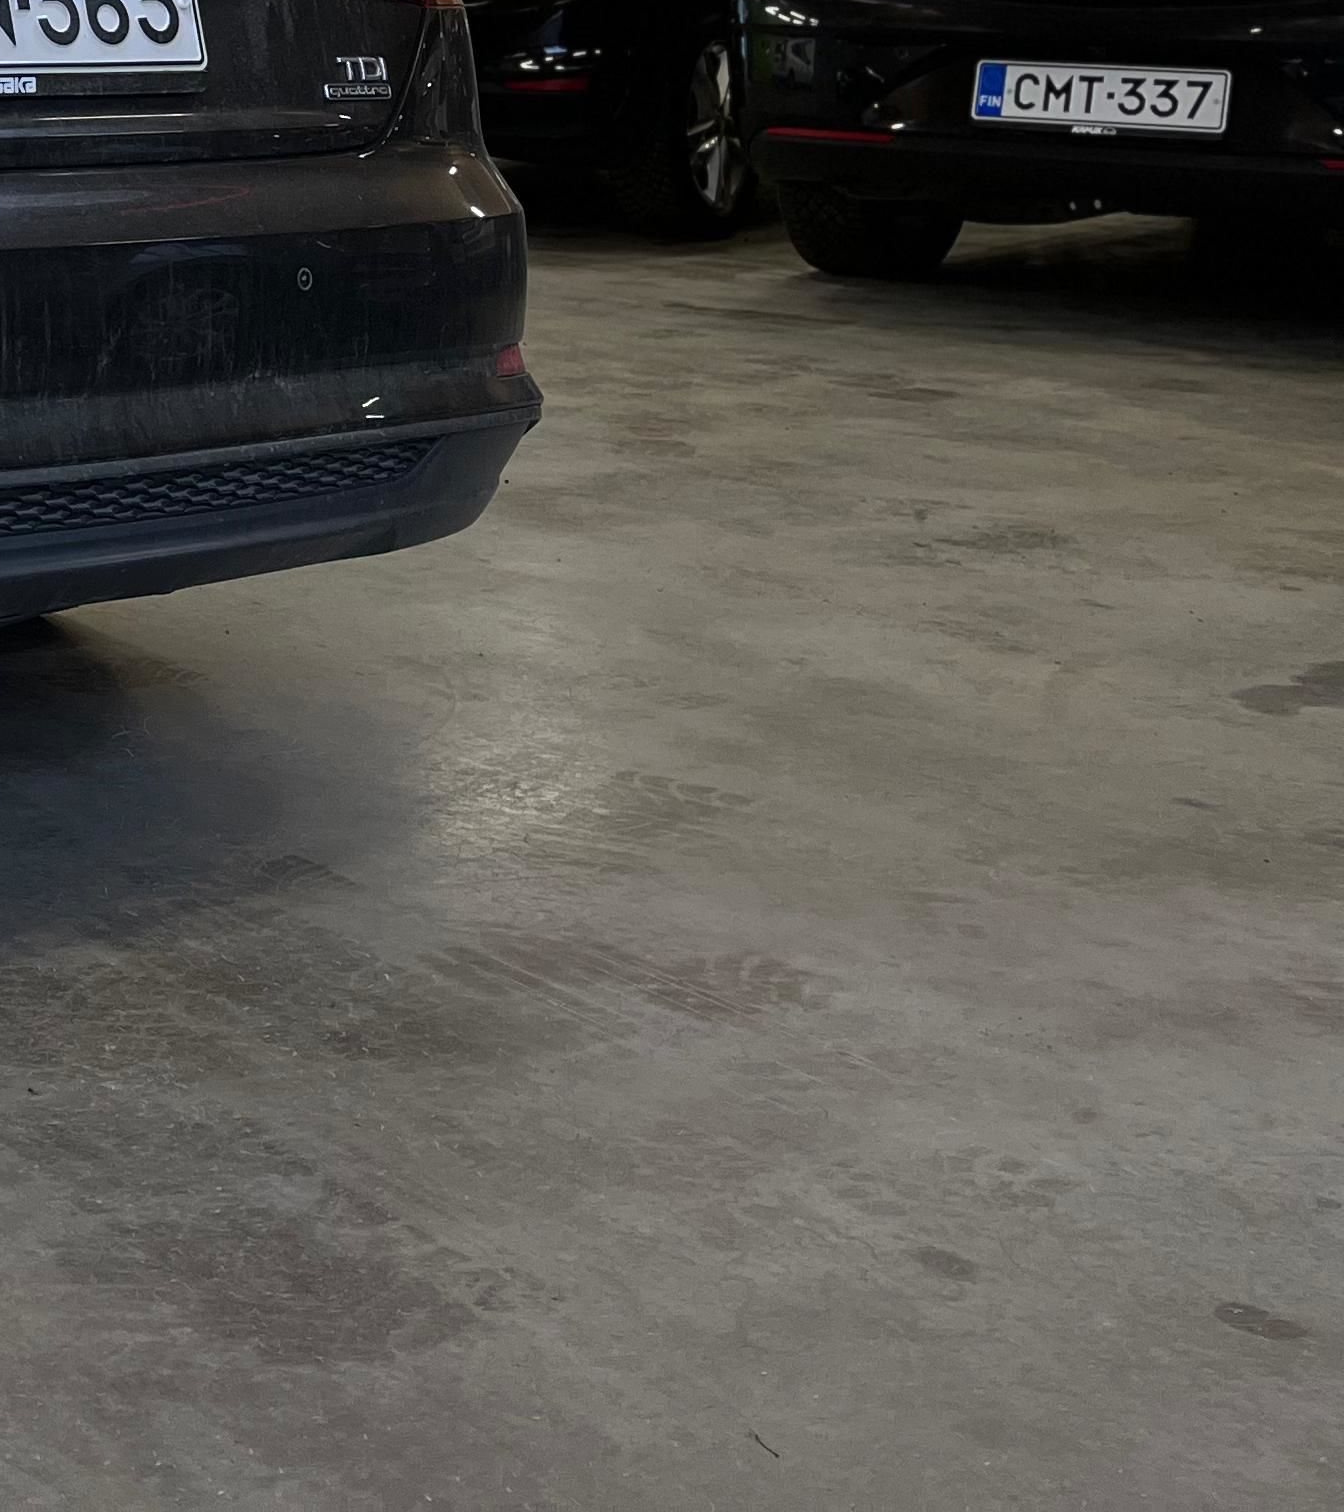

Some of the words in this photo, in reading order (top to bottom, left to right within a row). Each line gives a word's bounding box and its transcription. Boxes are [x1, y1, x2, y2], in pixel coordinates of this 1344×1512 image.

[336, 56, 387, 81] TDI
[329, 85, 389, 98] quattro
[979, 94, 1002, 108] FIN
[1013, 73, 1213, 120] CMT-337
